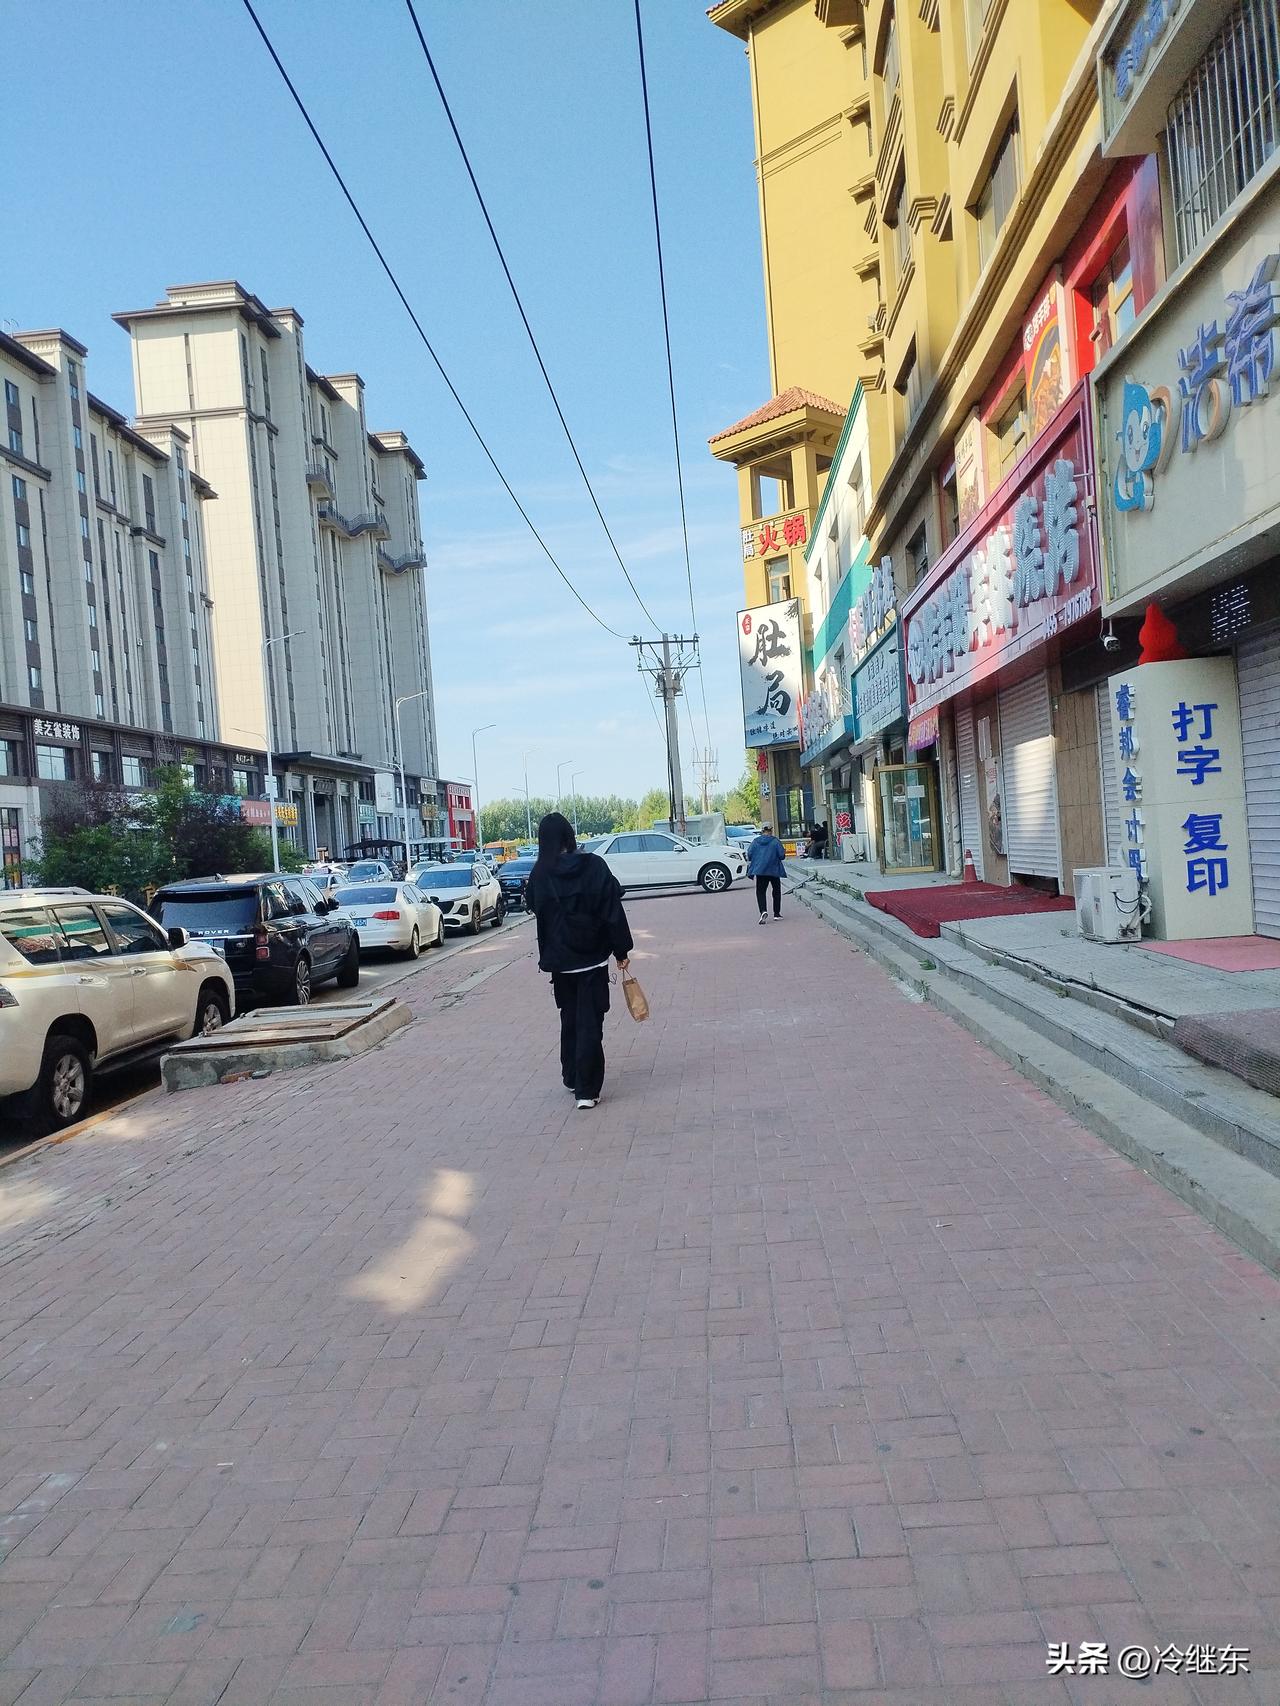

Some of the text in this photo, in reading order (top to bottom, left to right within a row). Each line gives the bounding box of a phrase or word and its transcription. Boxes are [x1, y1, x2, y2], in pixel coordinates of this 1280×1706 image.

[742, 514, 806, 558] 肚局 火锅
[748, 619, 791, 715] 肚局
[1171, 702, 1229, 896] 打字 复印
